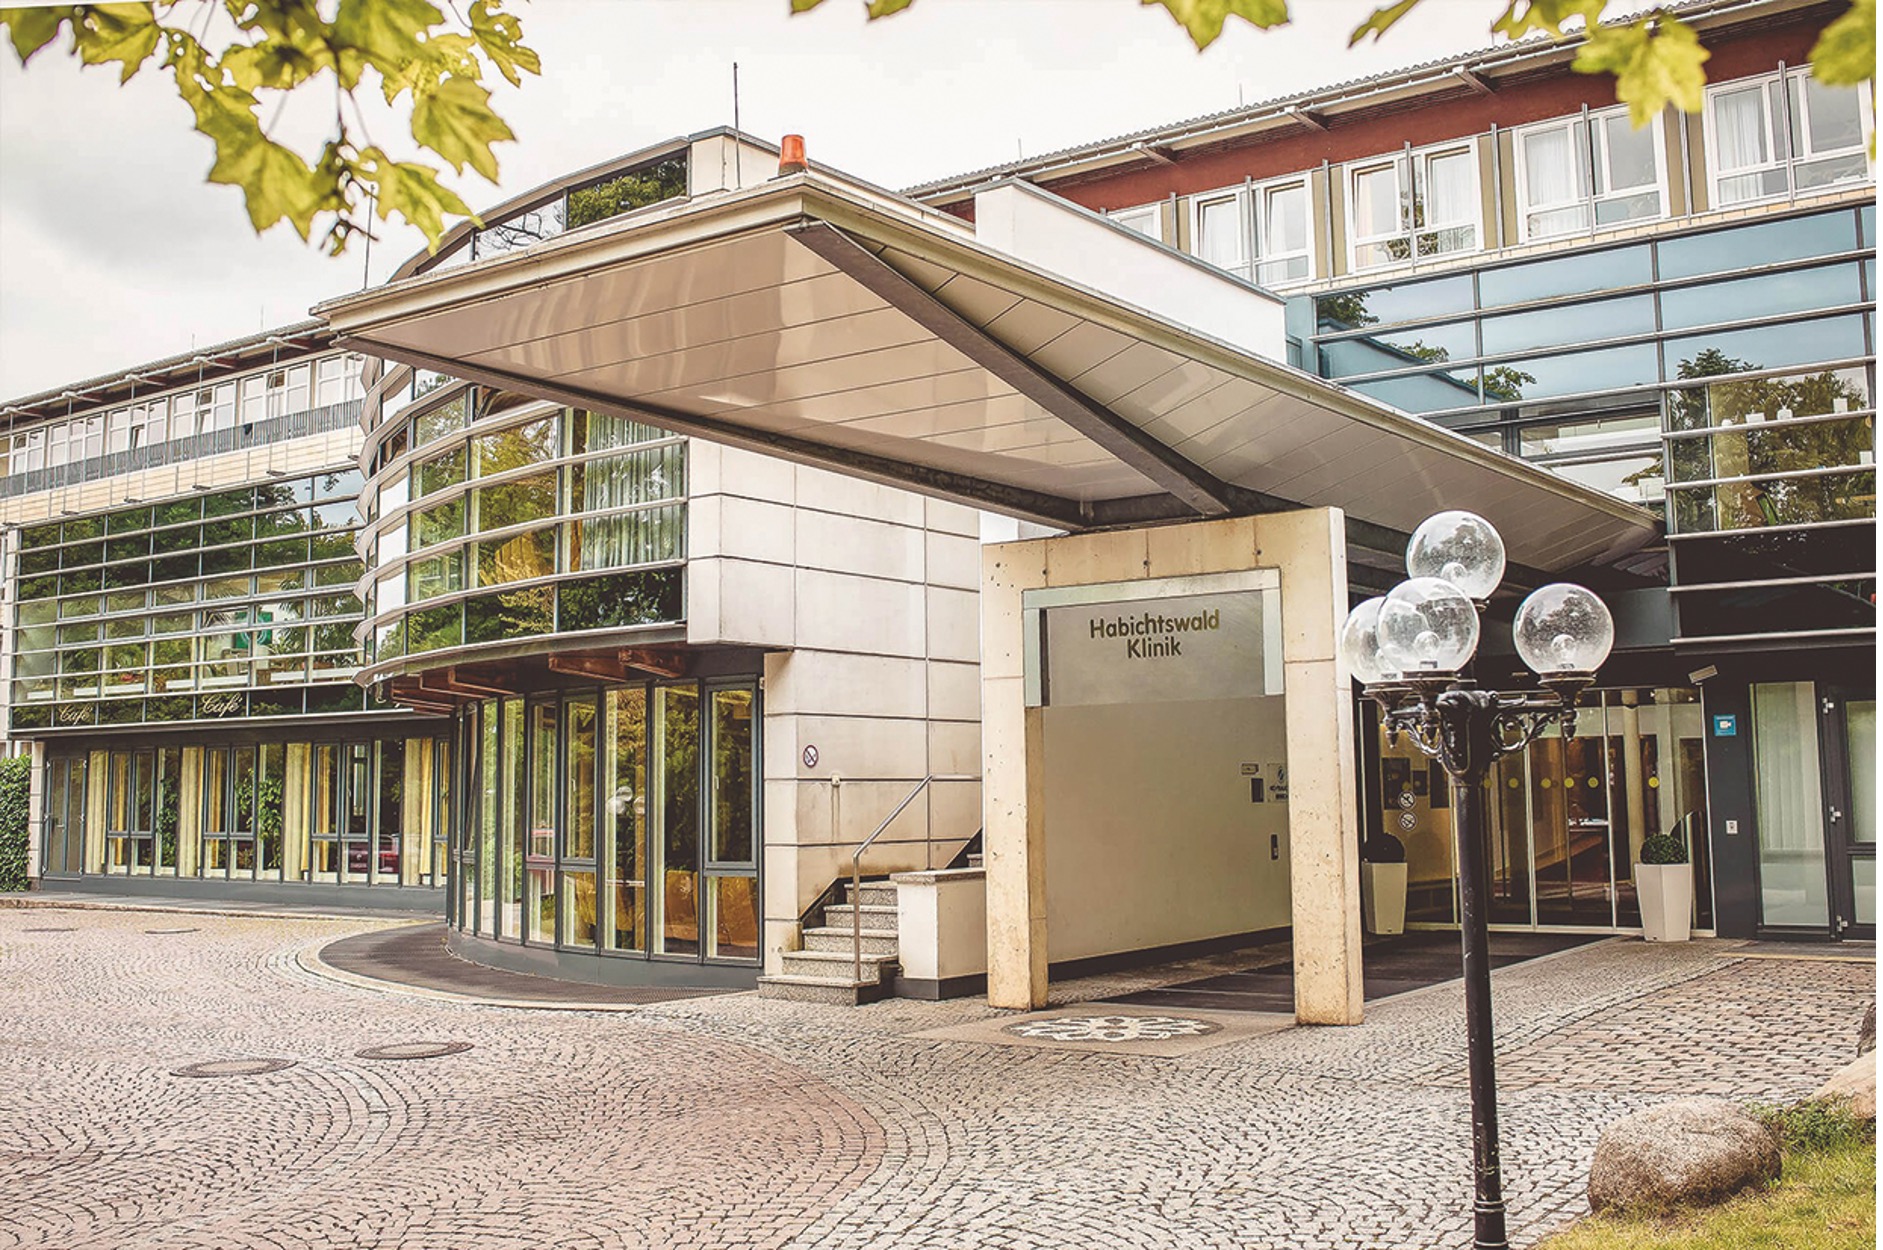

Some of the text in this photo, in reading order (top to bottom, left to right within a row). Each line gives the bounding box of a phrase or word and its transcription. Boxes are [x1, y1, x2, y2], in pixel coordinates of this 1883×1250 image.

[1090, 609, 1219, 638] Habichtswald
[1127, 636, 1182, 658] Klinik
[58, 703, 93, 726] Café
[202, 692, 243, 717] Café
